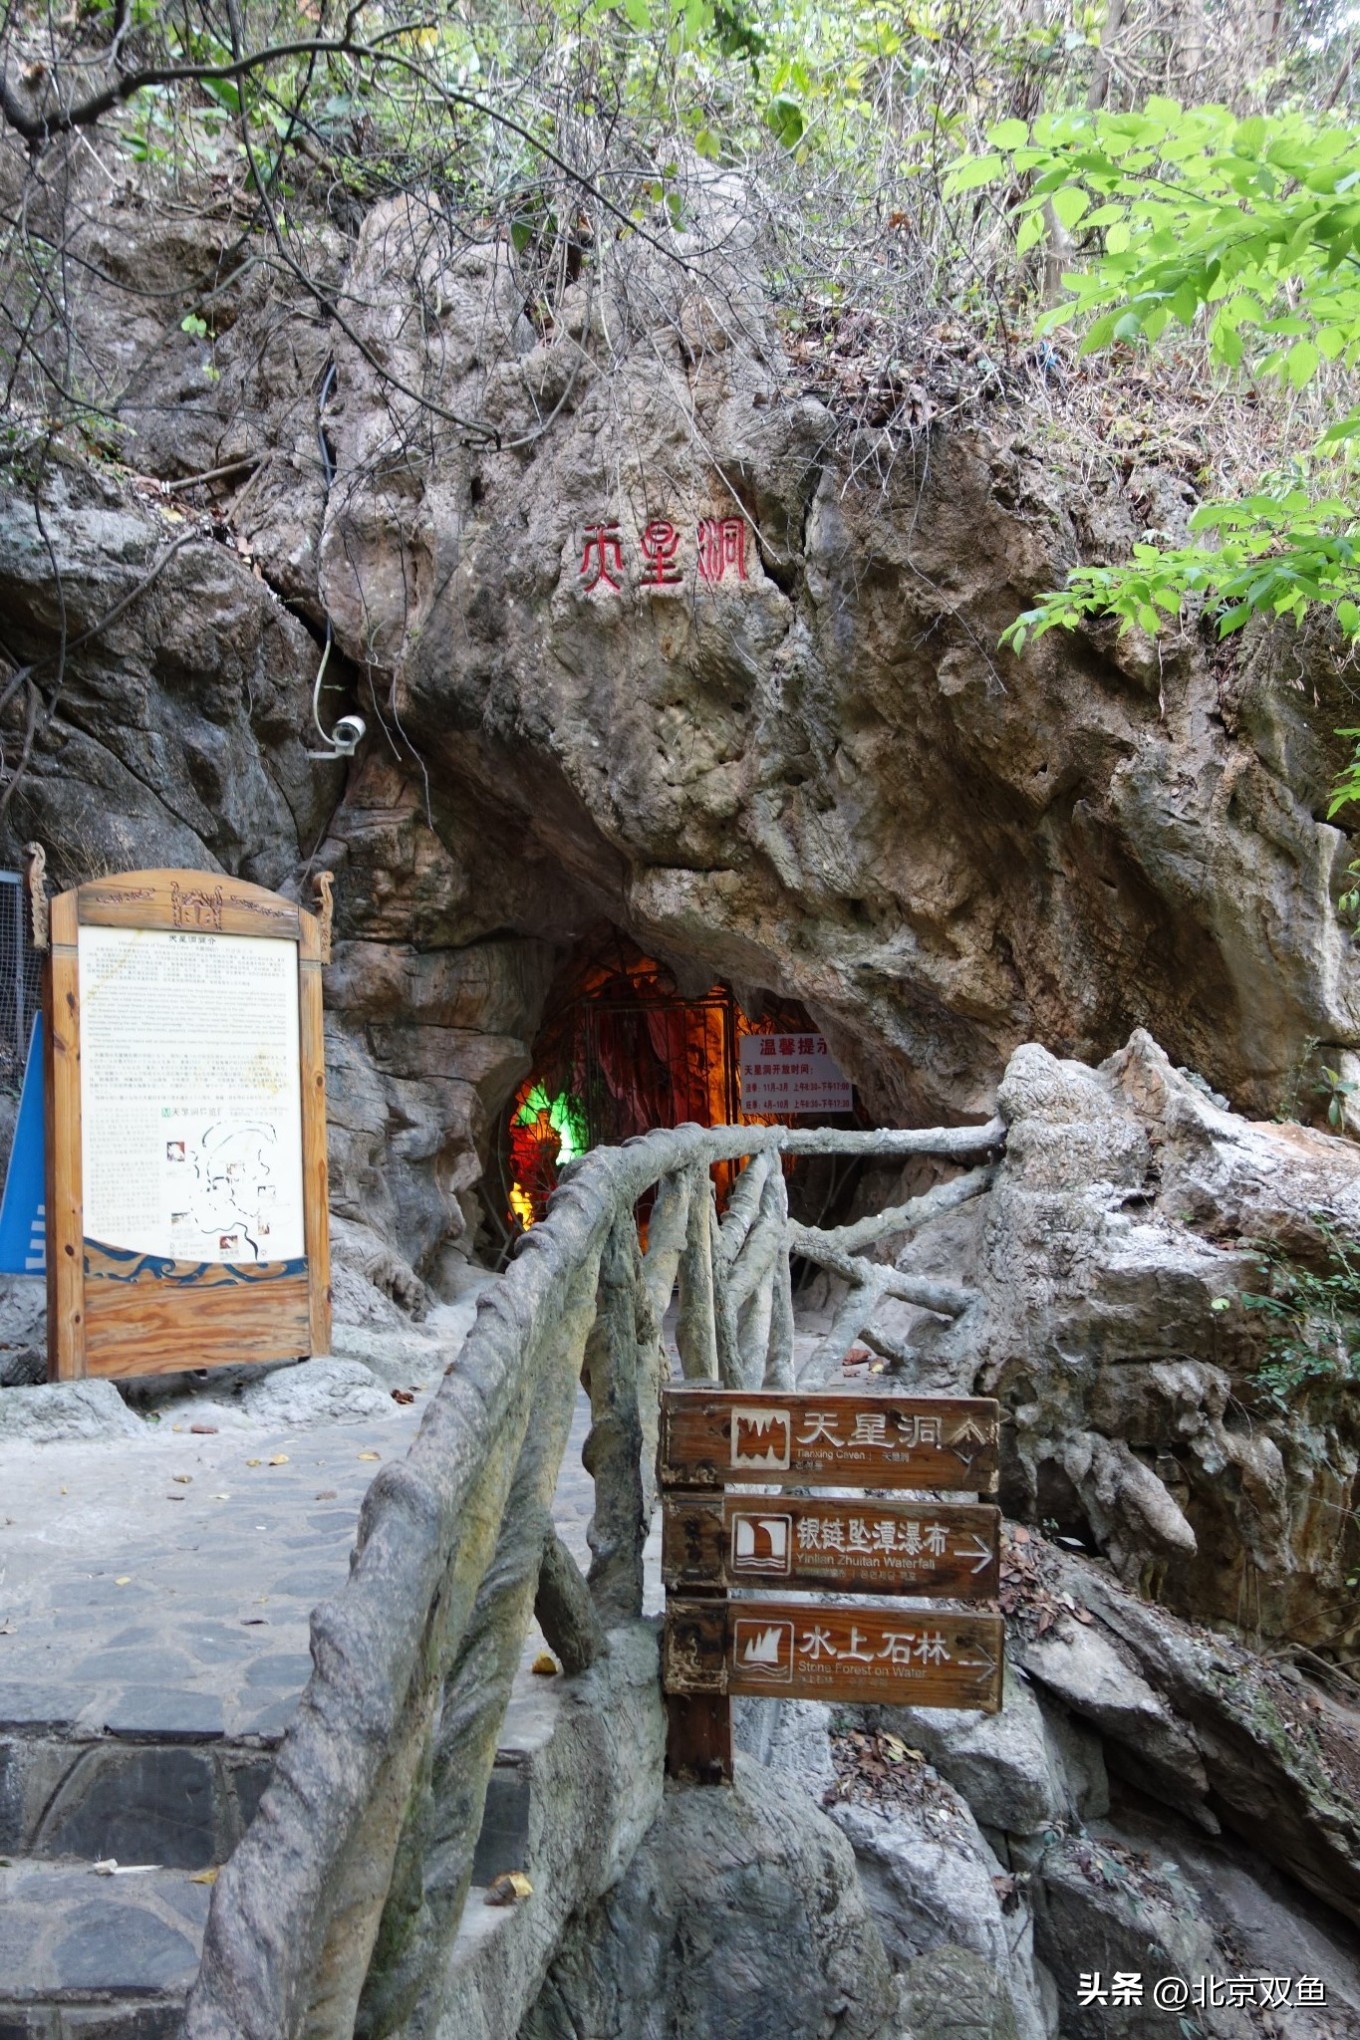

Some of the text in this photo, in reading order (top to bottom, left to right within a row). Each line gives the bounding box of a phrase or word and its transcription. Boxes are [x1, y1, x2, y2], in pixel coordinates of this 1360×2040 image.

[796, 1412, 942, 1450] 天星洞
[797, 1449, 833, 1461] Tianxing
[797, 1516, 950, 1557] 银链坠潭瀑布
[797, 1553, 936, 1570] Yinlian Zhuitan Waterfall
[799, 1624, 952, 1666] 水上石林
[798, 1660, 927, 1679] Stone Forest on Water
